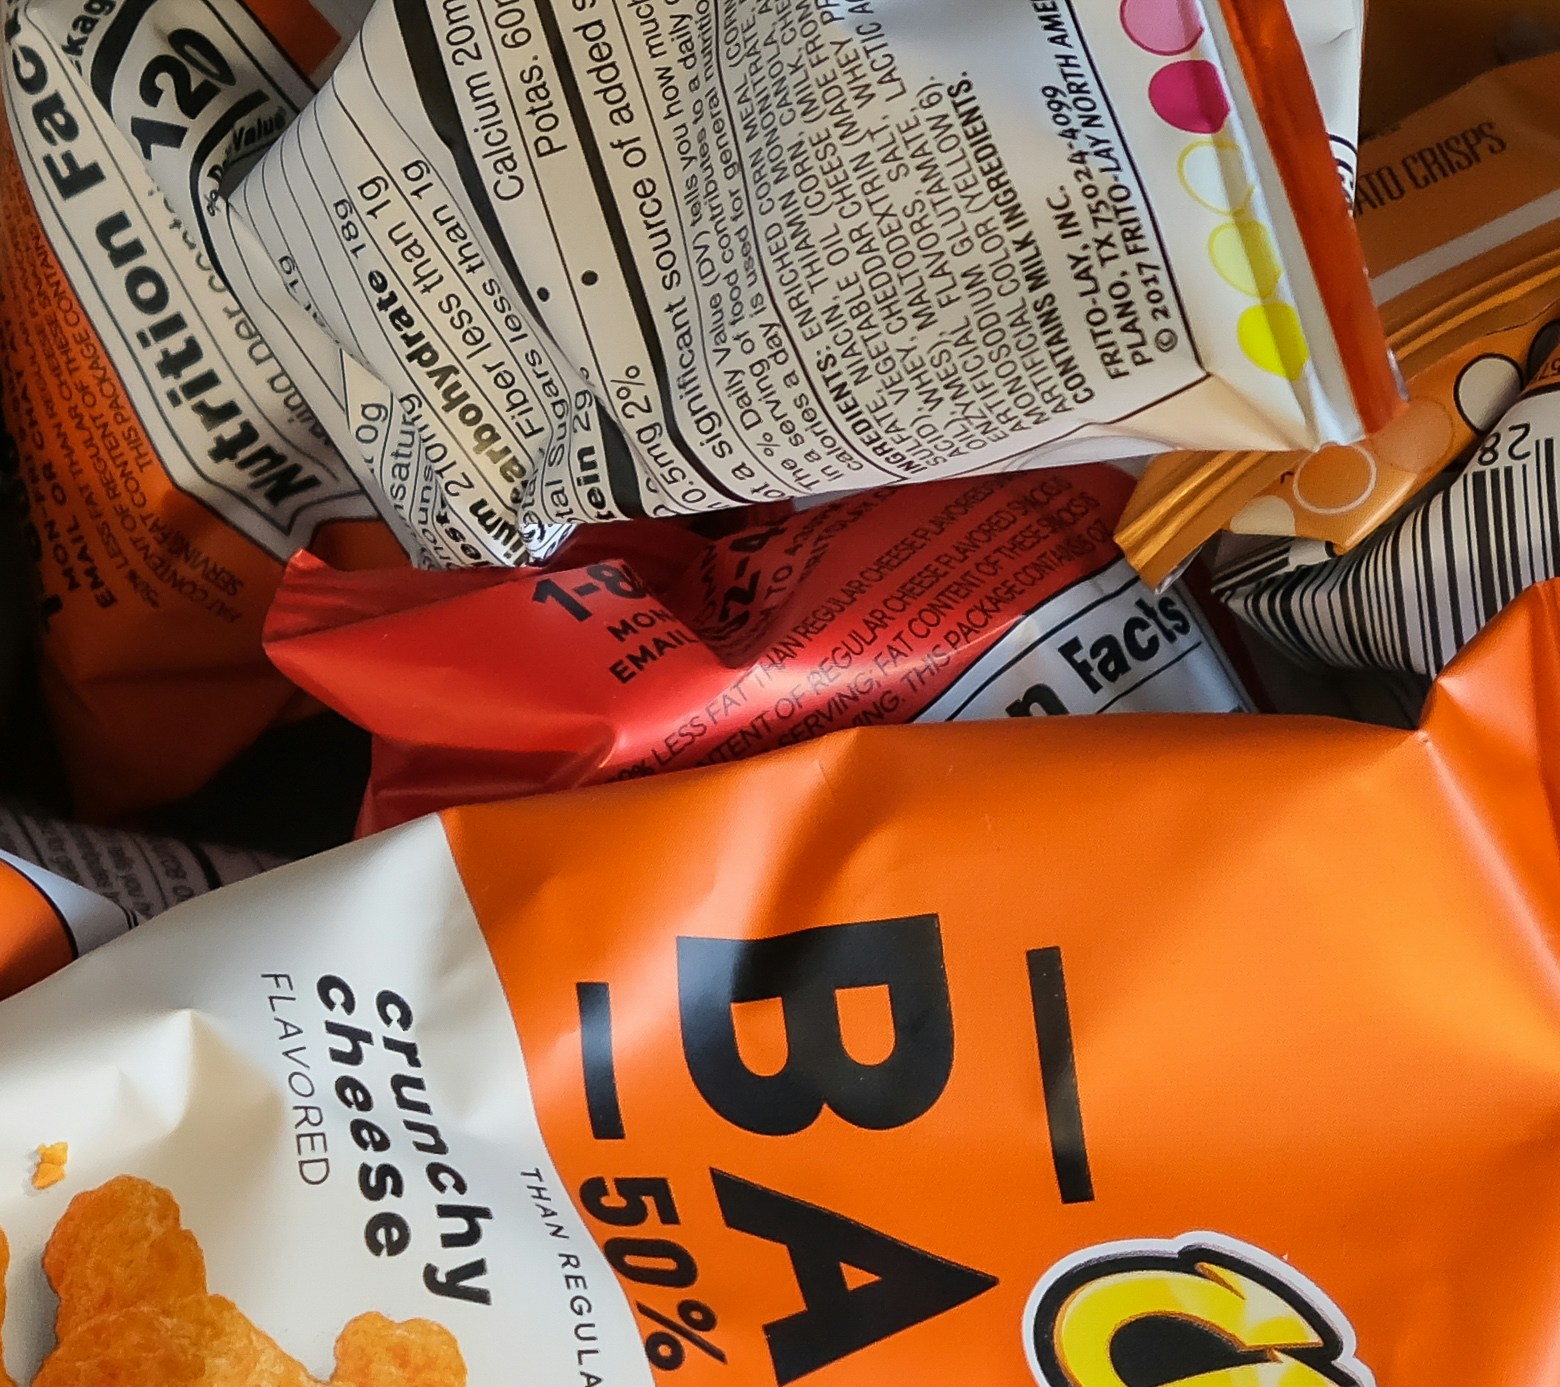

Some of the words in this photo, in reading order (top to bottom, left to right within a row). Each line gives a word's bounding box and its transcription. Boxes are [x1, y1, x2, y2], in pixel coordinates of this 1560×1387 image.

[948, 70, 1030, 236] INGREDIENTS.
[1406, 120, 1508, 190] CRISPS
[1019, 241, 1049, 293] MILK
[1036, 291, 1096, 405] CONTAINS
[1058, 594, 1192, 694] Facts
[260, 973, 330, 1185] FLAVORED
[316, 974, 412, 1259] cheese
[375, 989, 493, 1305] crunchy
[520, 1167, 569, 1239] THAN
[579, 1175, 728, 1369] 50%
